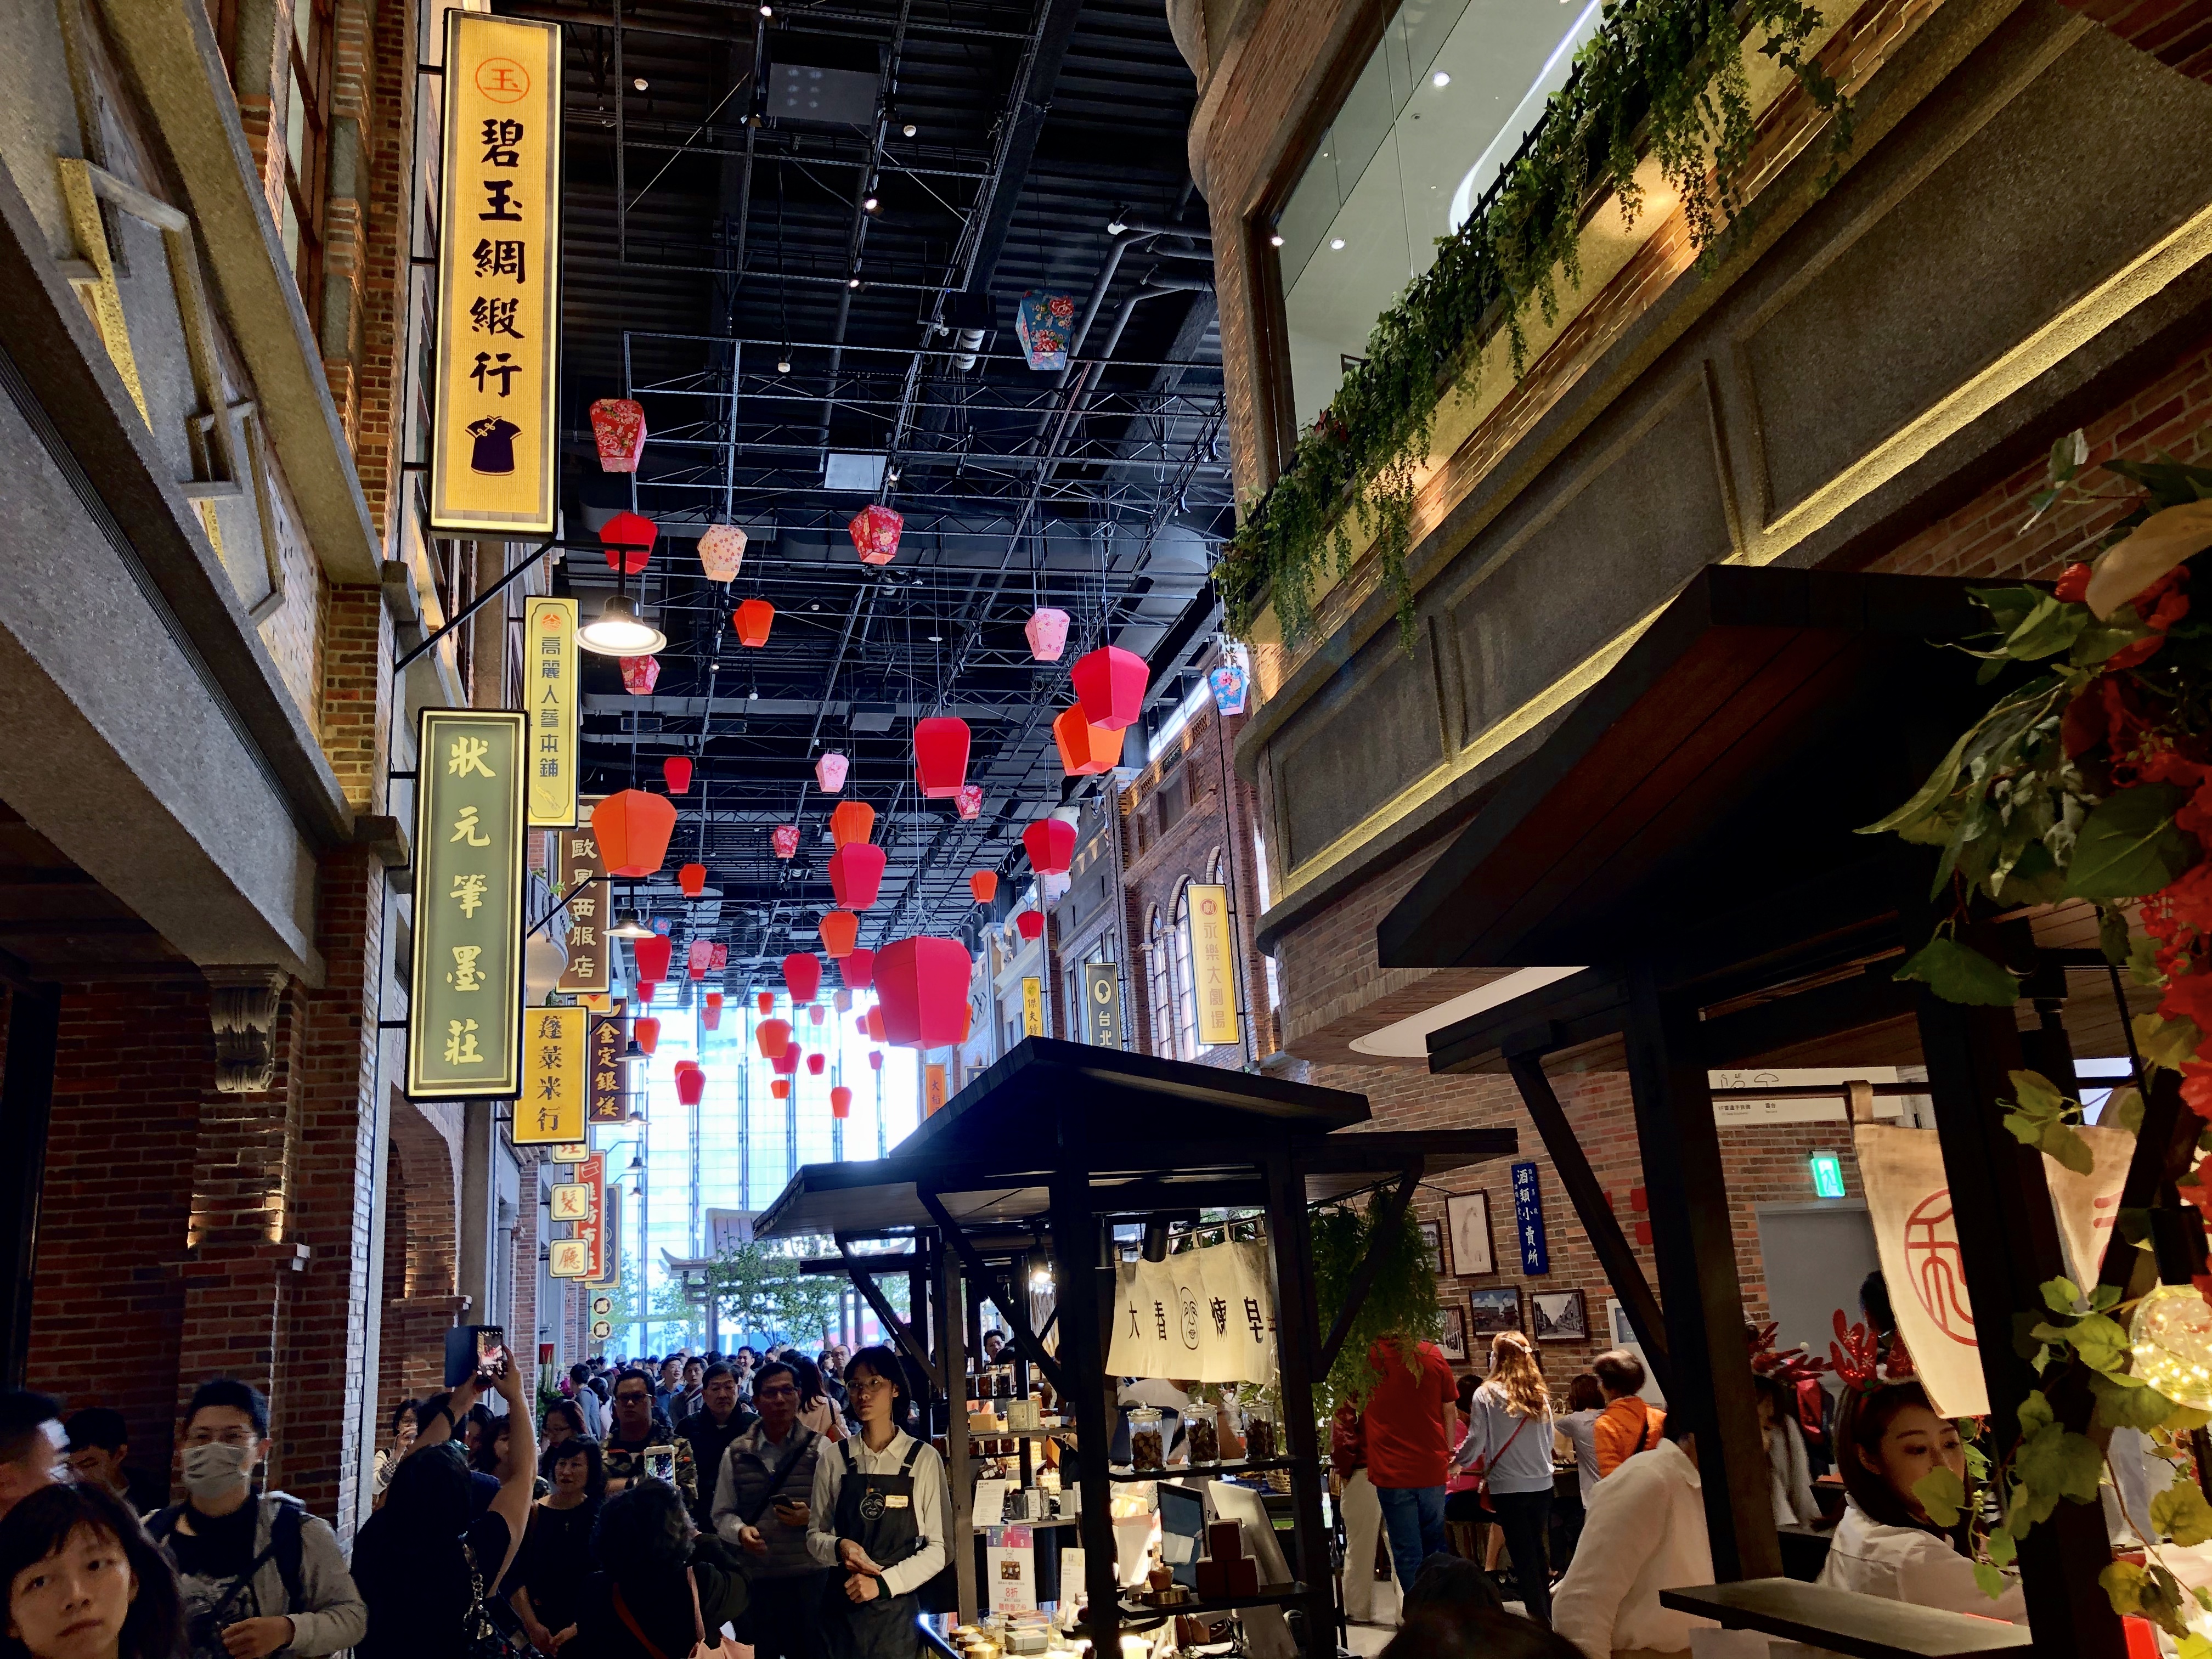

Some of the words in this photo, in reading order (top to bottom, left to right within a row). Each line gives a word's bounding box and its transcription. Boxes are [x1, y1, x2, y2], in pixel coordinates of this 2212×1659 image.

[485, 69, 523, 93] 玉
[469, 118, 526, 398] 碧玉綢緞行
[445, 736, 496, 1065] 狀元筆墨莊
[570, 838, 598, 978] 歐風西服店
[1099, 1011, 1113, 1046] 台北
[1203, 922, 1225, 1029] 永樂大劇場
[537, 1015, 563, 1132] 蓬萊米行
[1517, 1169, 1538, 1267] 酒類小賣所
